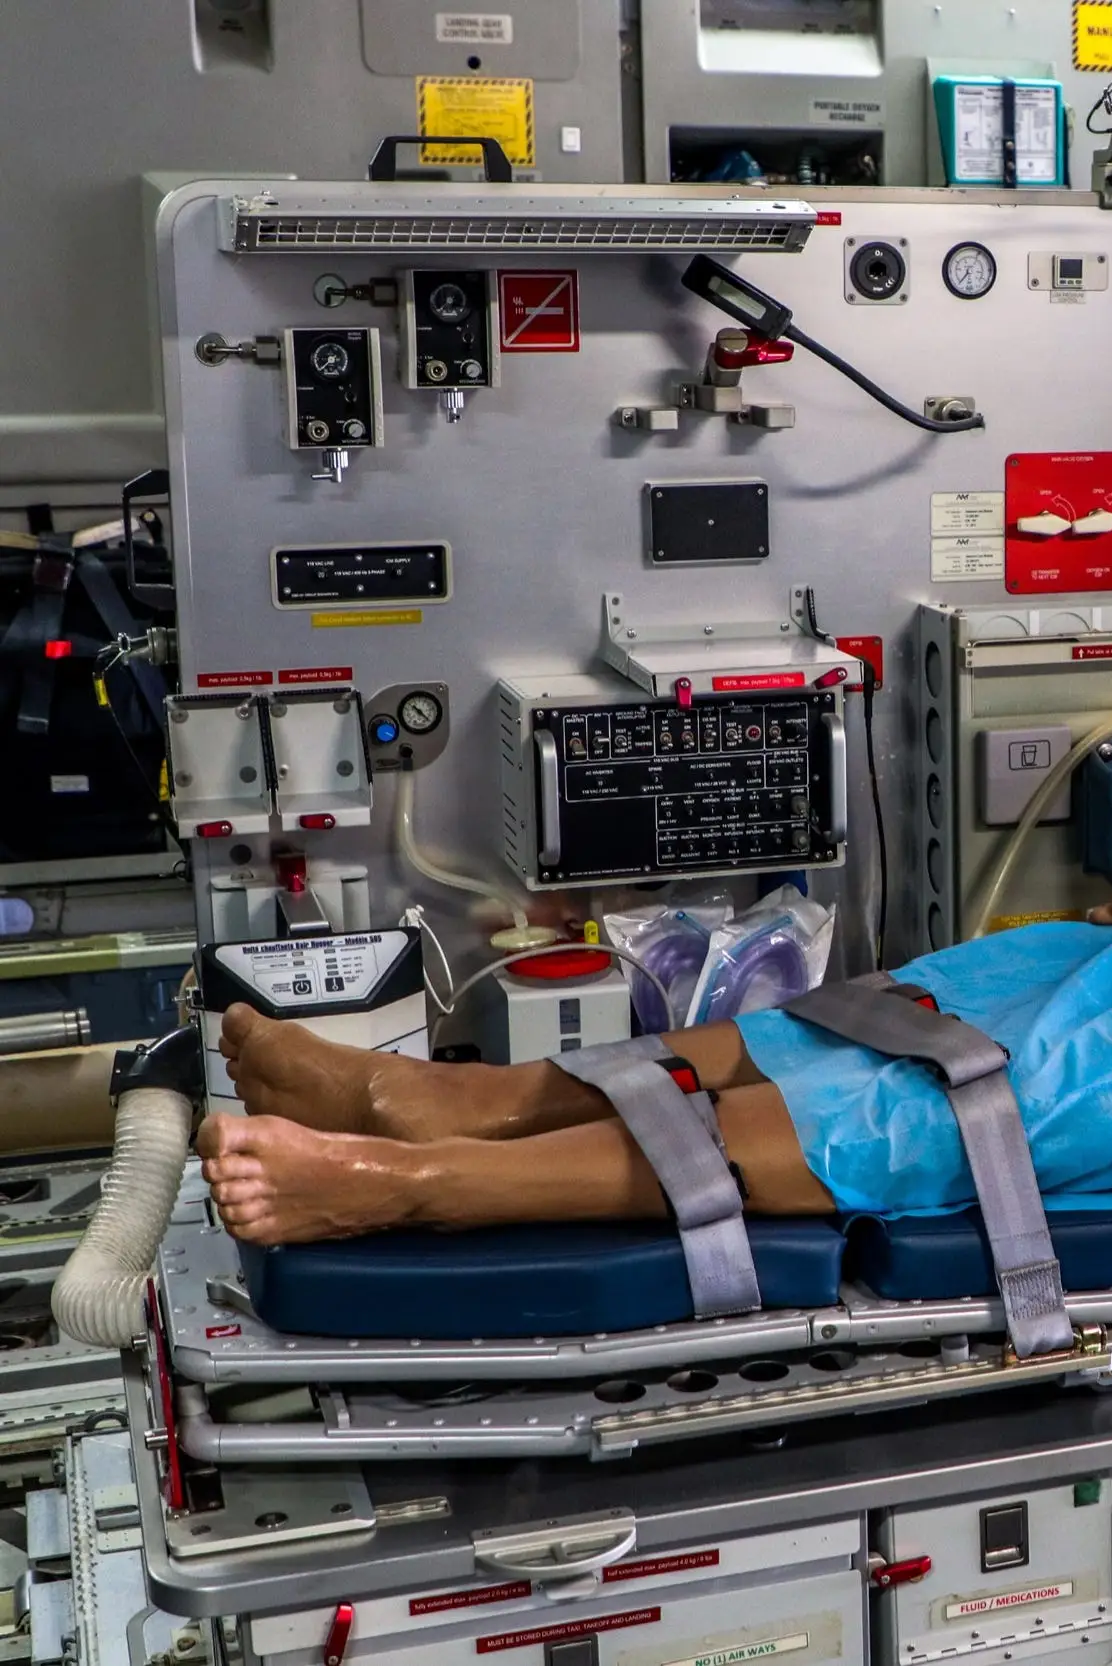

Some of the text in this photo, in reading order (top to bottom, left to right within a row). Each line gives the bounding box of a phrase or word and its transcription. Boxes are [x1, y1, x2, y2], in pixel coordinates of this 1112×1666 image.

[619, 1567, 643, 1575] extended
[658, 1561, 678, 1570] payload
[427, 1599, 453, 1608] extended
[469, 1592, 491, 1602] payload
[960, 1587, 1059, 1613] FLUID / MEDICATIONS
[488, 1639, 504, 1648] MUST
[516, 1632, 541, 1642] STORED
[542, 1628, 565, 1638] DURING
[611, 1616, 624, 1624] AND
[625, 1612, 651, 1622] LANDING
[713, 1654, 726, 1665] (1)
[729, 1651, 745, 1660] AIR
[748, 1643, 776, 1656] WAYS
